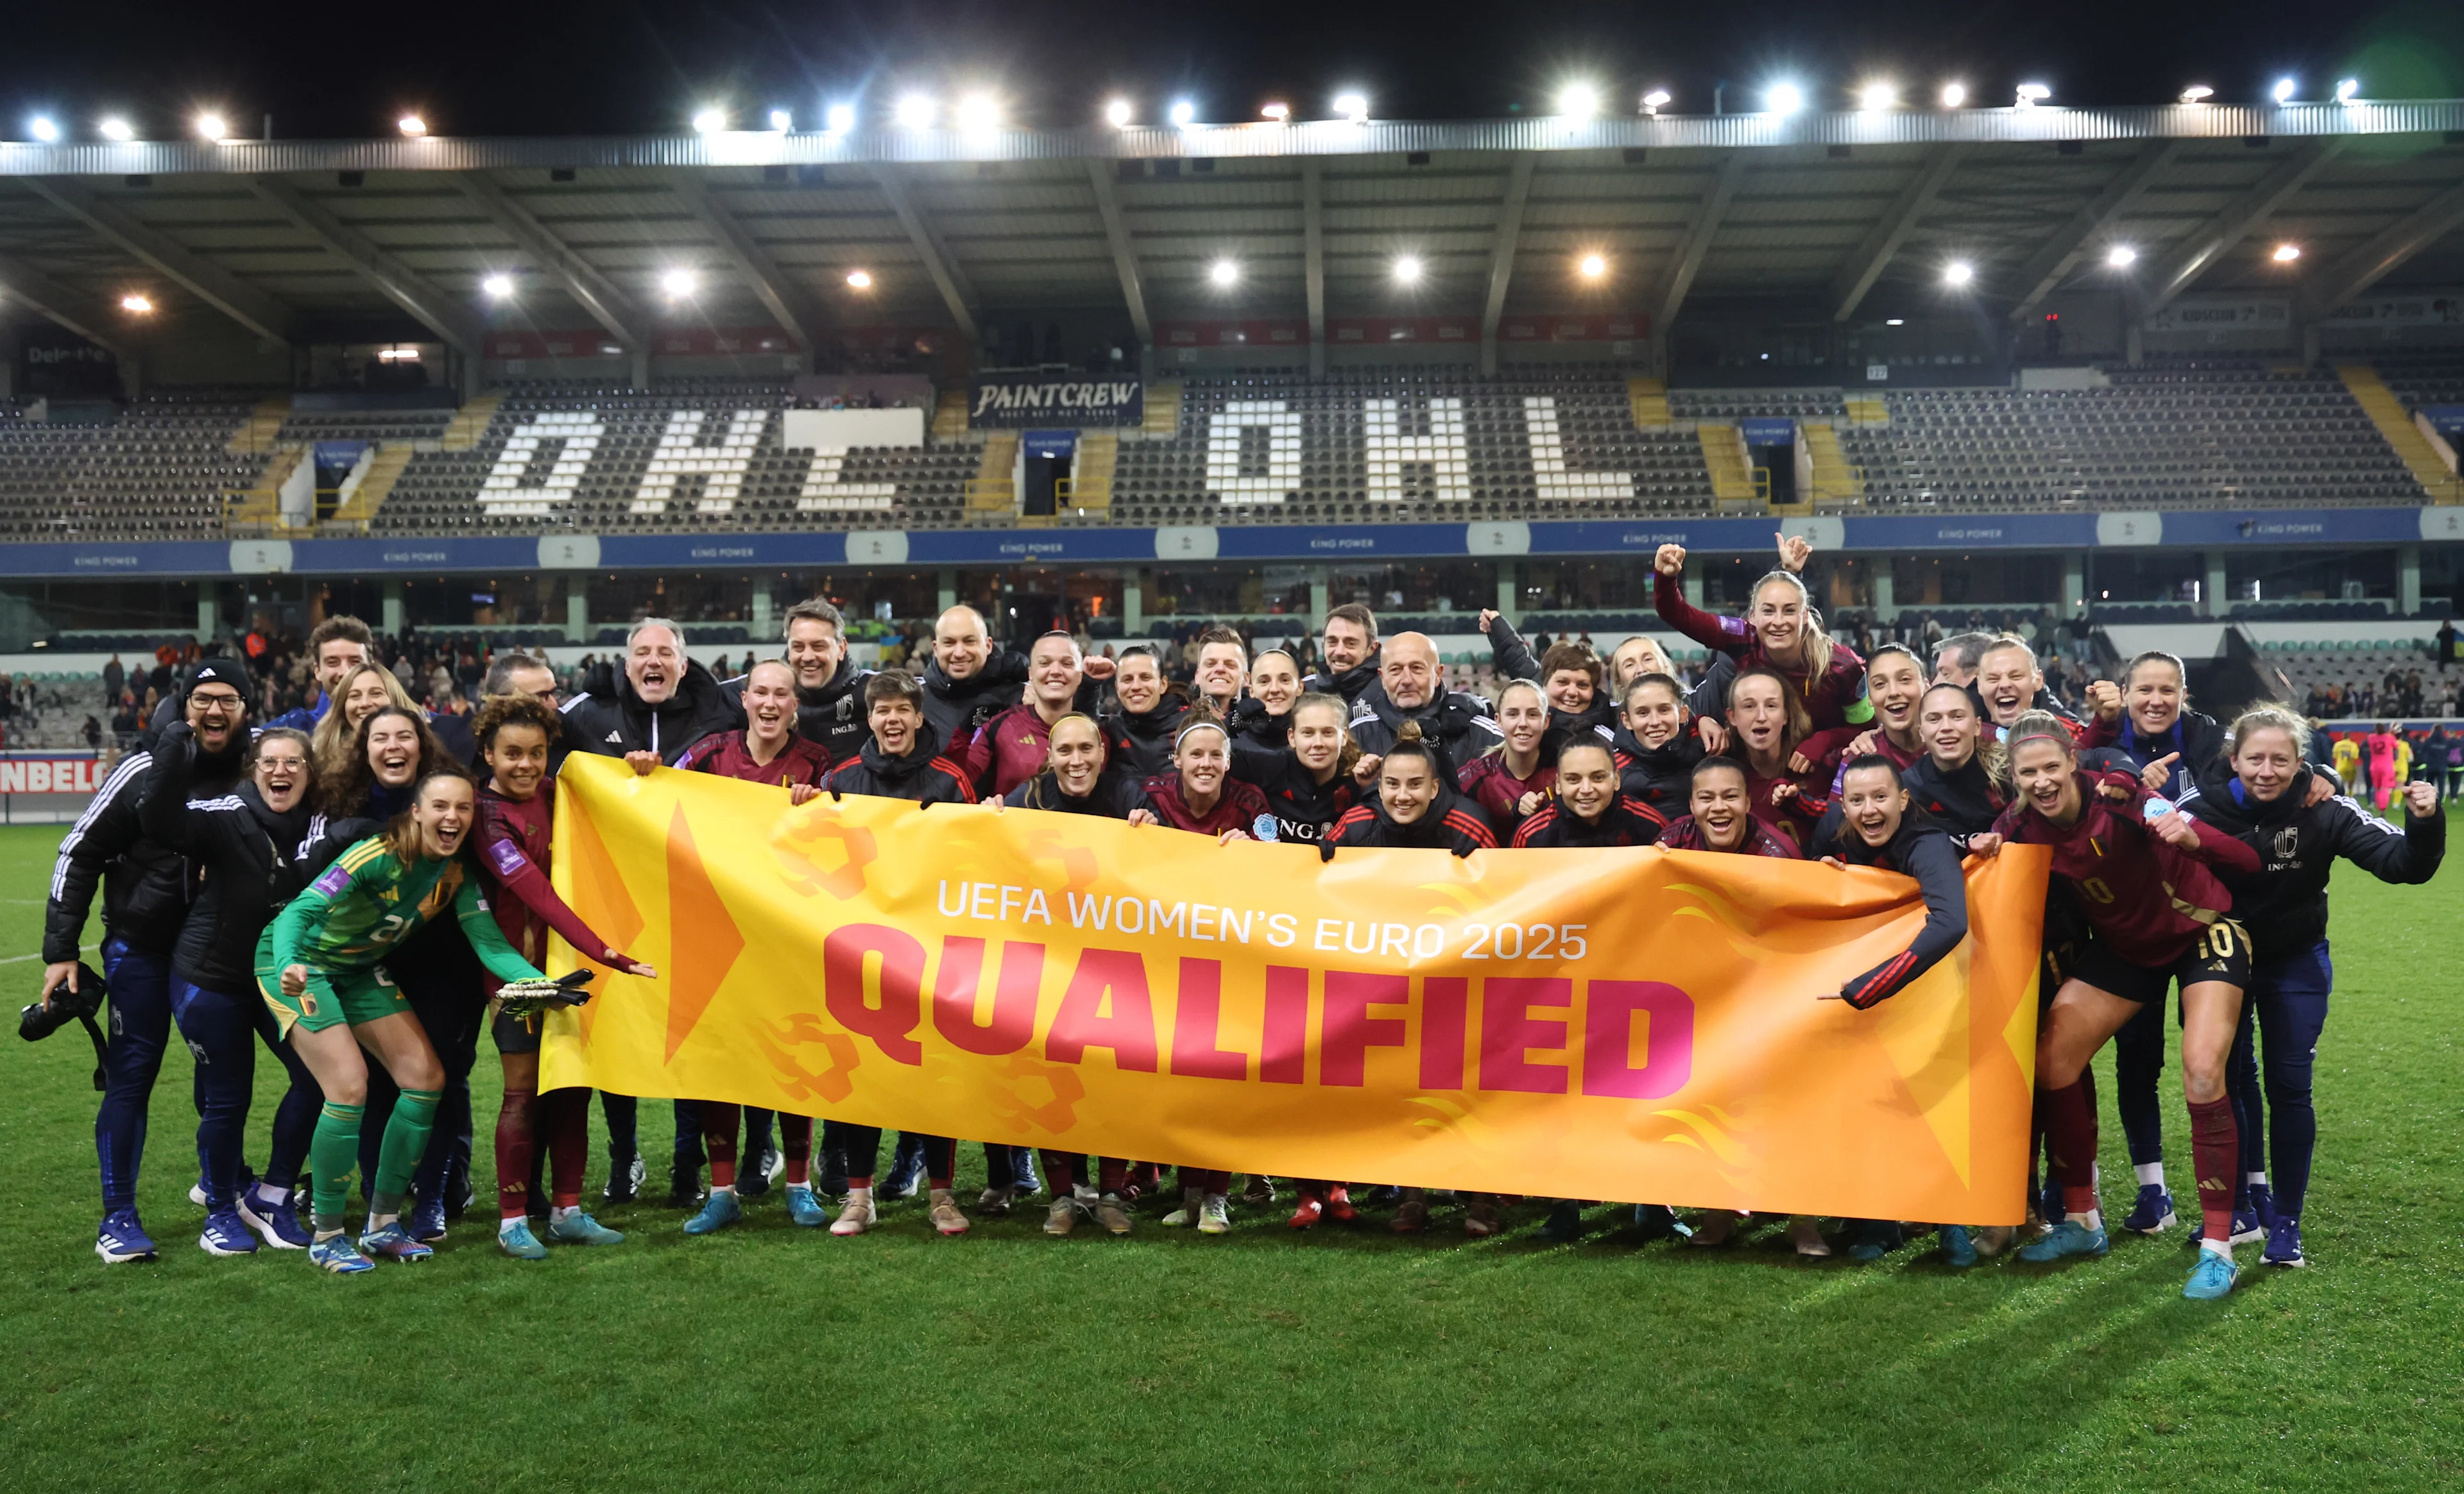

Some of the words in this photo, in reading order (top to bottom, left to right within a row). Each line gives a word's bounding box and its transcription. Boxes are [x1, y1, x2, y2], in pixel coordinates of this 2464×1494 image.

[971, 382, 1139, 417] PAINTCREW
[1937, 529, 1965, 538] KING
[1966, 529, 2002, 538] POWER
[2257, 524, 2284, 533] KING
[2286, 524, 2323, 533] POWER
[1000, 544, 1026, 553] KING
[1028, 544, 1063, 553] POWER
[1310, 539, 1337, 549] KING
[1339, 539, 1374, 549] POWER
[384, 553, 409, 562] KING
[411, 553, 447, 562] POWER
[691, 548, 717, 557] KING
[719, 548, 754, 557] POWER
[74, 556, 101, 566] KING
[103, 556, 139, 566] POWER
[832, 726, 847, 735] ING
[938, 879, 1052, 925] UEFA
[1067, 891, 1297, 948] WOMEN'S
[1313, 918, 1444, 959] EURO
[1461, 924, 1587, 960] 2025
[370, 914, 415, 943] 21
[2198, 922, 2234, 960] 10
[823, 922, 1695, 1100] QUALIFIED
